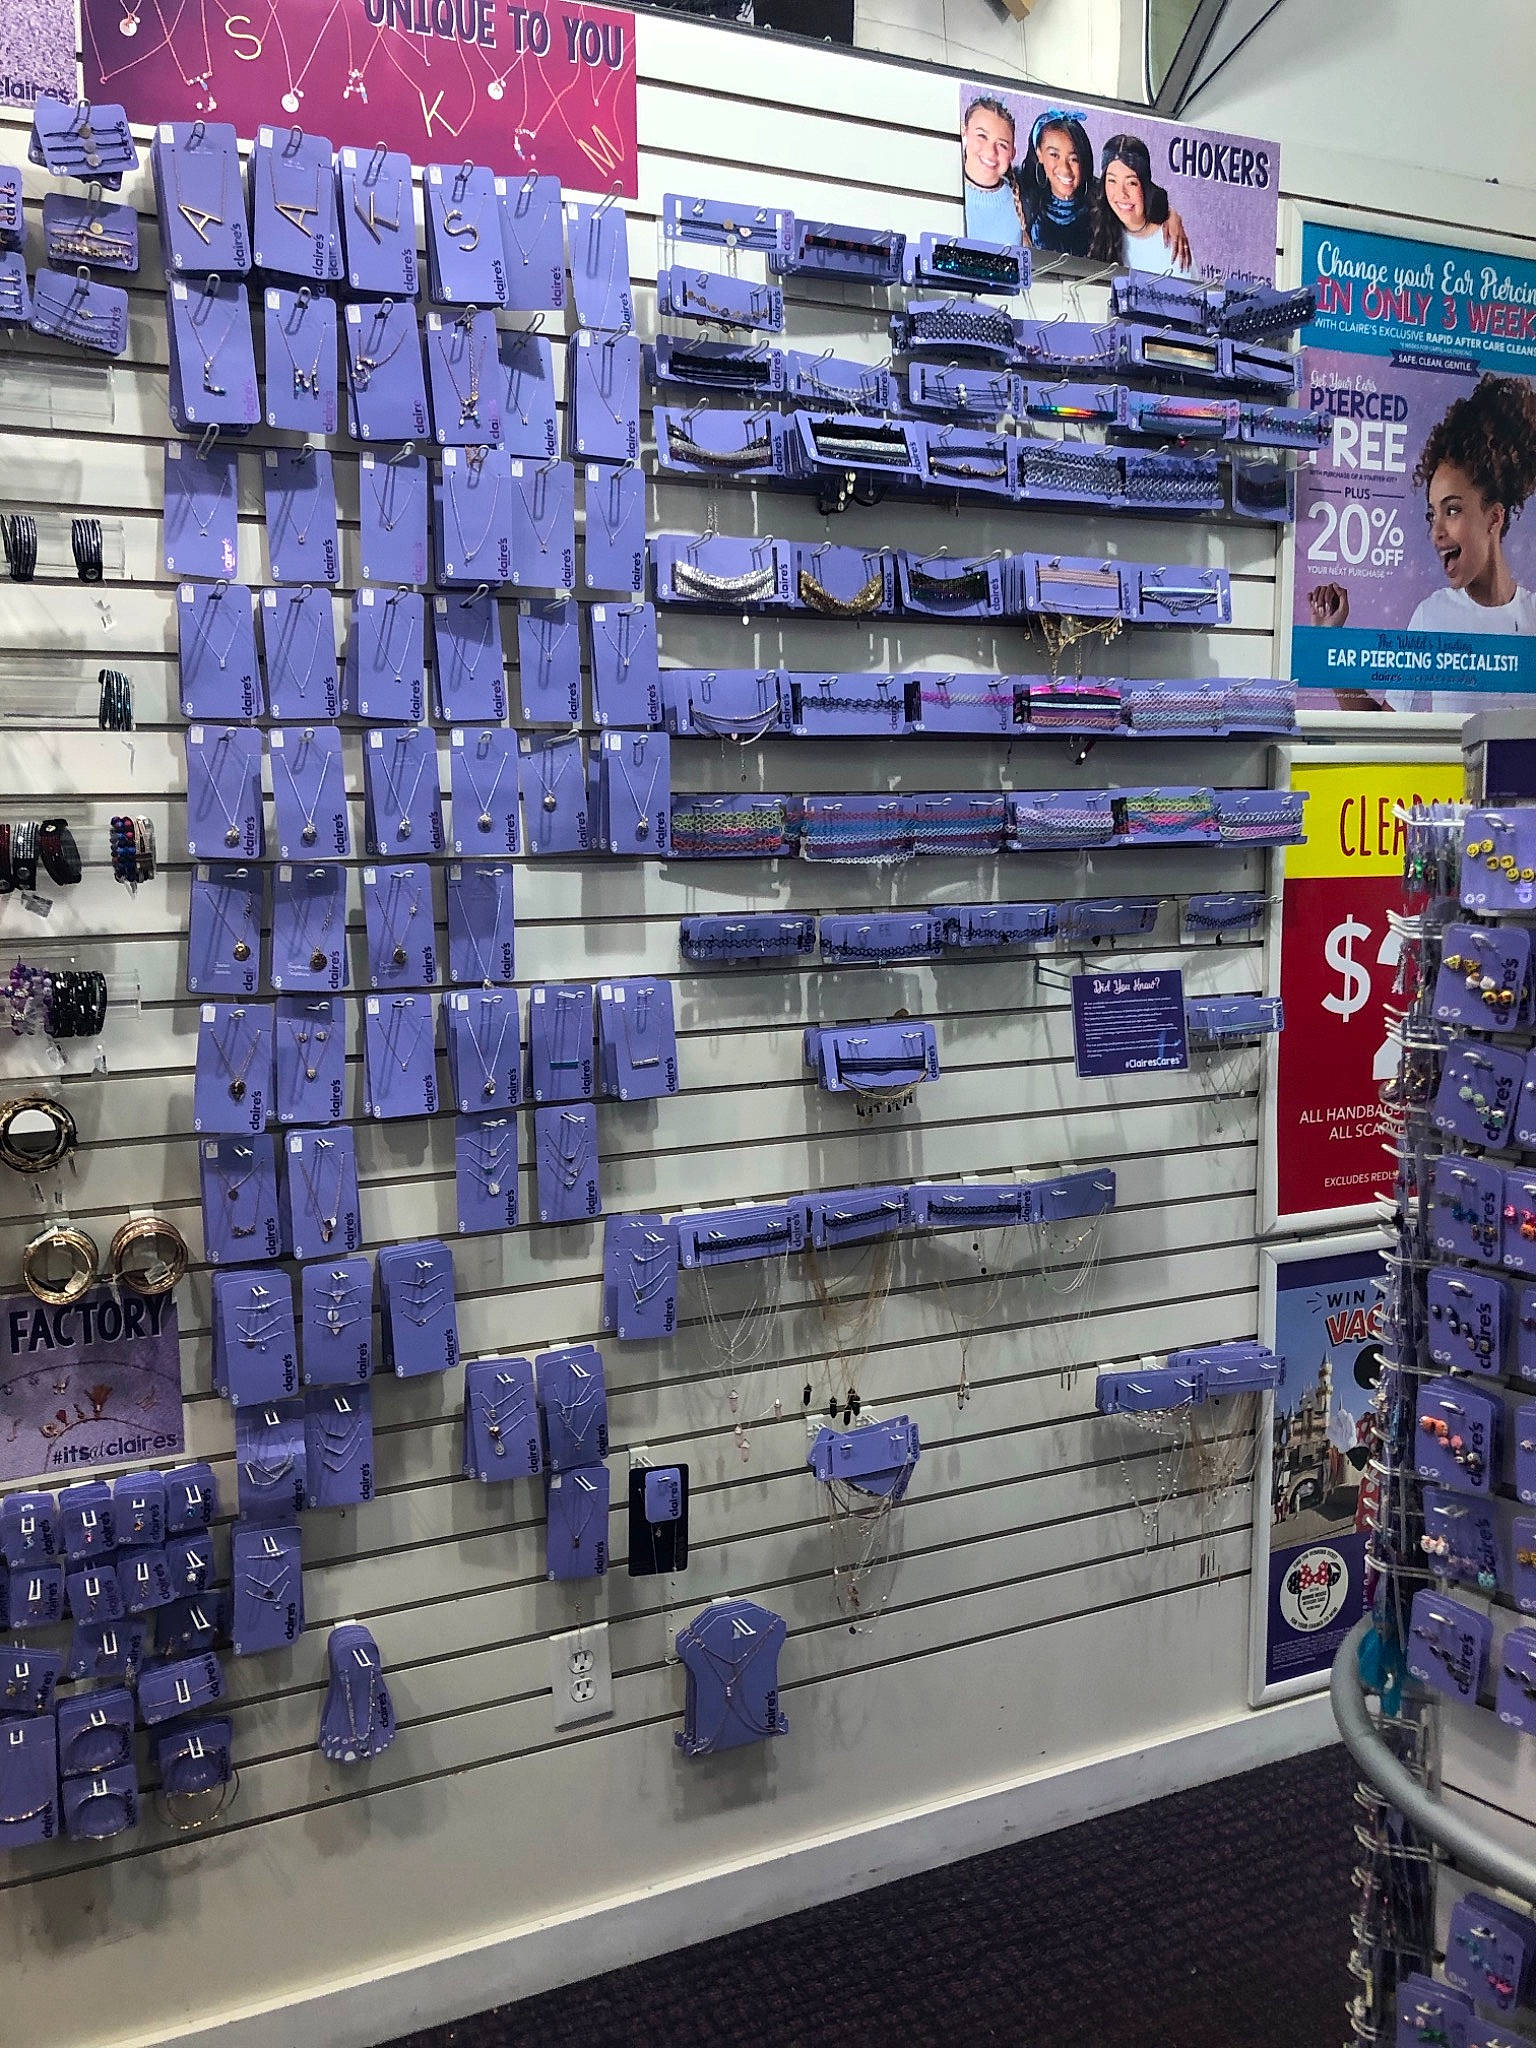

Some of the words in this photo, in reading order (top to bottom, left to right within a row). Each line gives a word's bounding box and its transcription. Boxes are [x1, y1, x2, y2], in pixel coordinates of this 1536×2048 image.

[364, 0, 496, 49] UNIQUE
[508, 5, 550, 57] TO
[562, 15, 623, 70] YOU
[1168, 136, 1269, 190] CHOKERS
[1317, 240, 1388, 287] Change
[1394, 263, 1434, 296] your
[1441, 261, 1473, 296] Ear
[1480, 266, 1536, 303] Piercin
[1316, 276, 1352, 316] IN
[1362, 288, 1433, 326] ONLY
[1440, 297, 1457, 330] 3
[1467, 300, 1536, 342] WEEK
[1315, 318, 1337, 329] WITH
[1338, 321, 1377, 336] CLAIRE'S
[1379, 324, 1424, 341] EXCLUSIVE
[1426, 333, 1453, 345] RAPID
[1455, 337, 1481, 348] AFTER
[1483, 340, 1504, 352] CARE
[1398, 354, 1418, 364] SAFE.
[1418, 357, 1443, 368] CLEAN.
[1444, 360, 1472, 371] GENTLE.
[1310, 387, 1408, 421] PIERCED
[1328, 649, 1356, 667] EAR
[1360, 651, 1431, 669] PIERCING
[1436, 652, 1518, 672] SPECIALIST!
[1327, 1290, 1366, 1308] WIN
[9, 1291, 172, 1355] FACTORY
